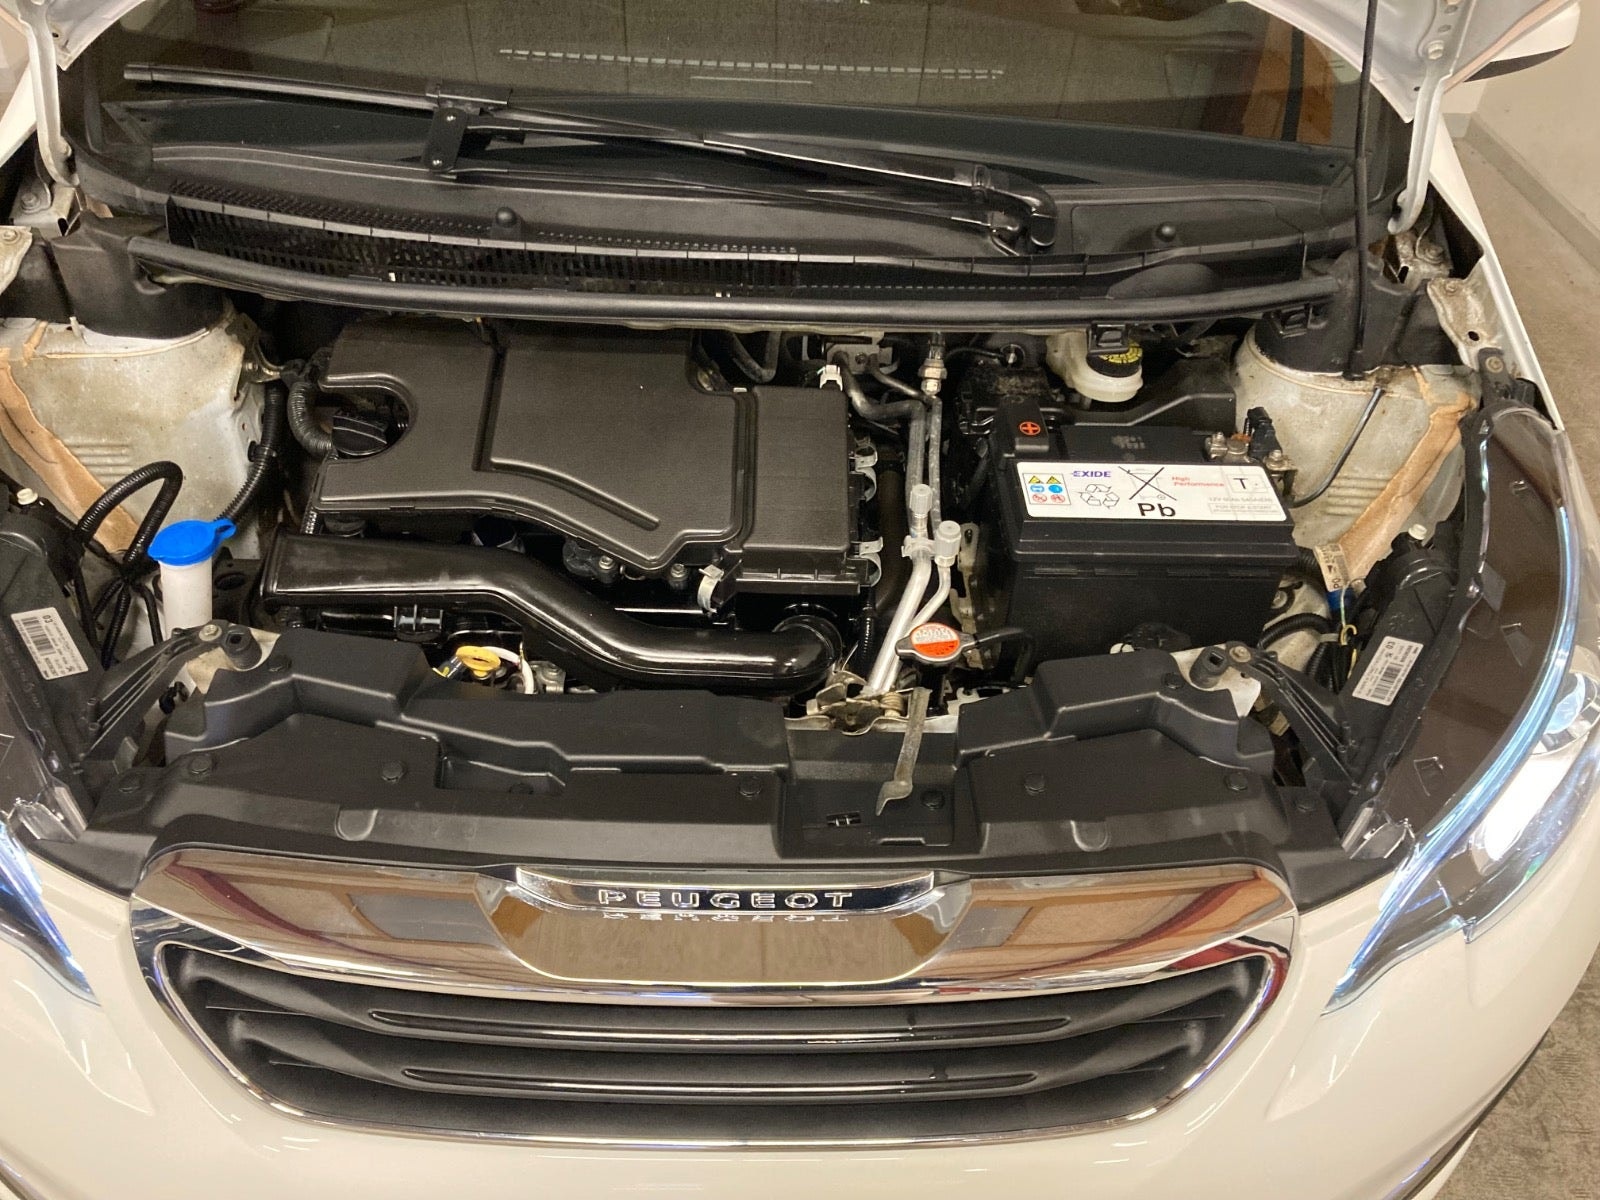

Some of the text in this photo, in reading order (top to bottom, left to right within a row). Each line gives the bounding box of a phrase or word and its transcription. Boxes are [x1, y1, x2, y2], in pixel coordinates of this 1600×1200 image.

[1071, 470, 1111, 478] EXIDE
[1233, 477, 1248, 490] T
[1137, 502, 1176, 517] Pb
[598, 889, 853, 909] PEUGEOT
